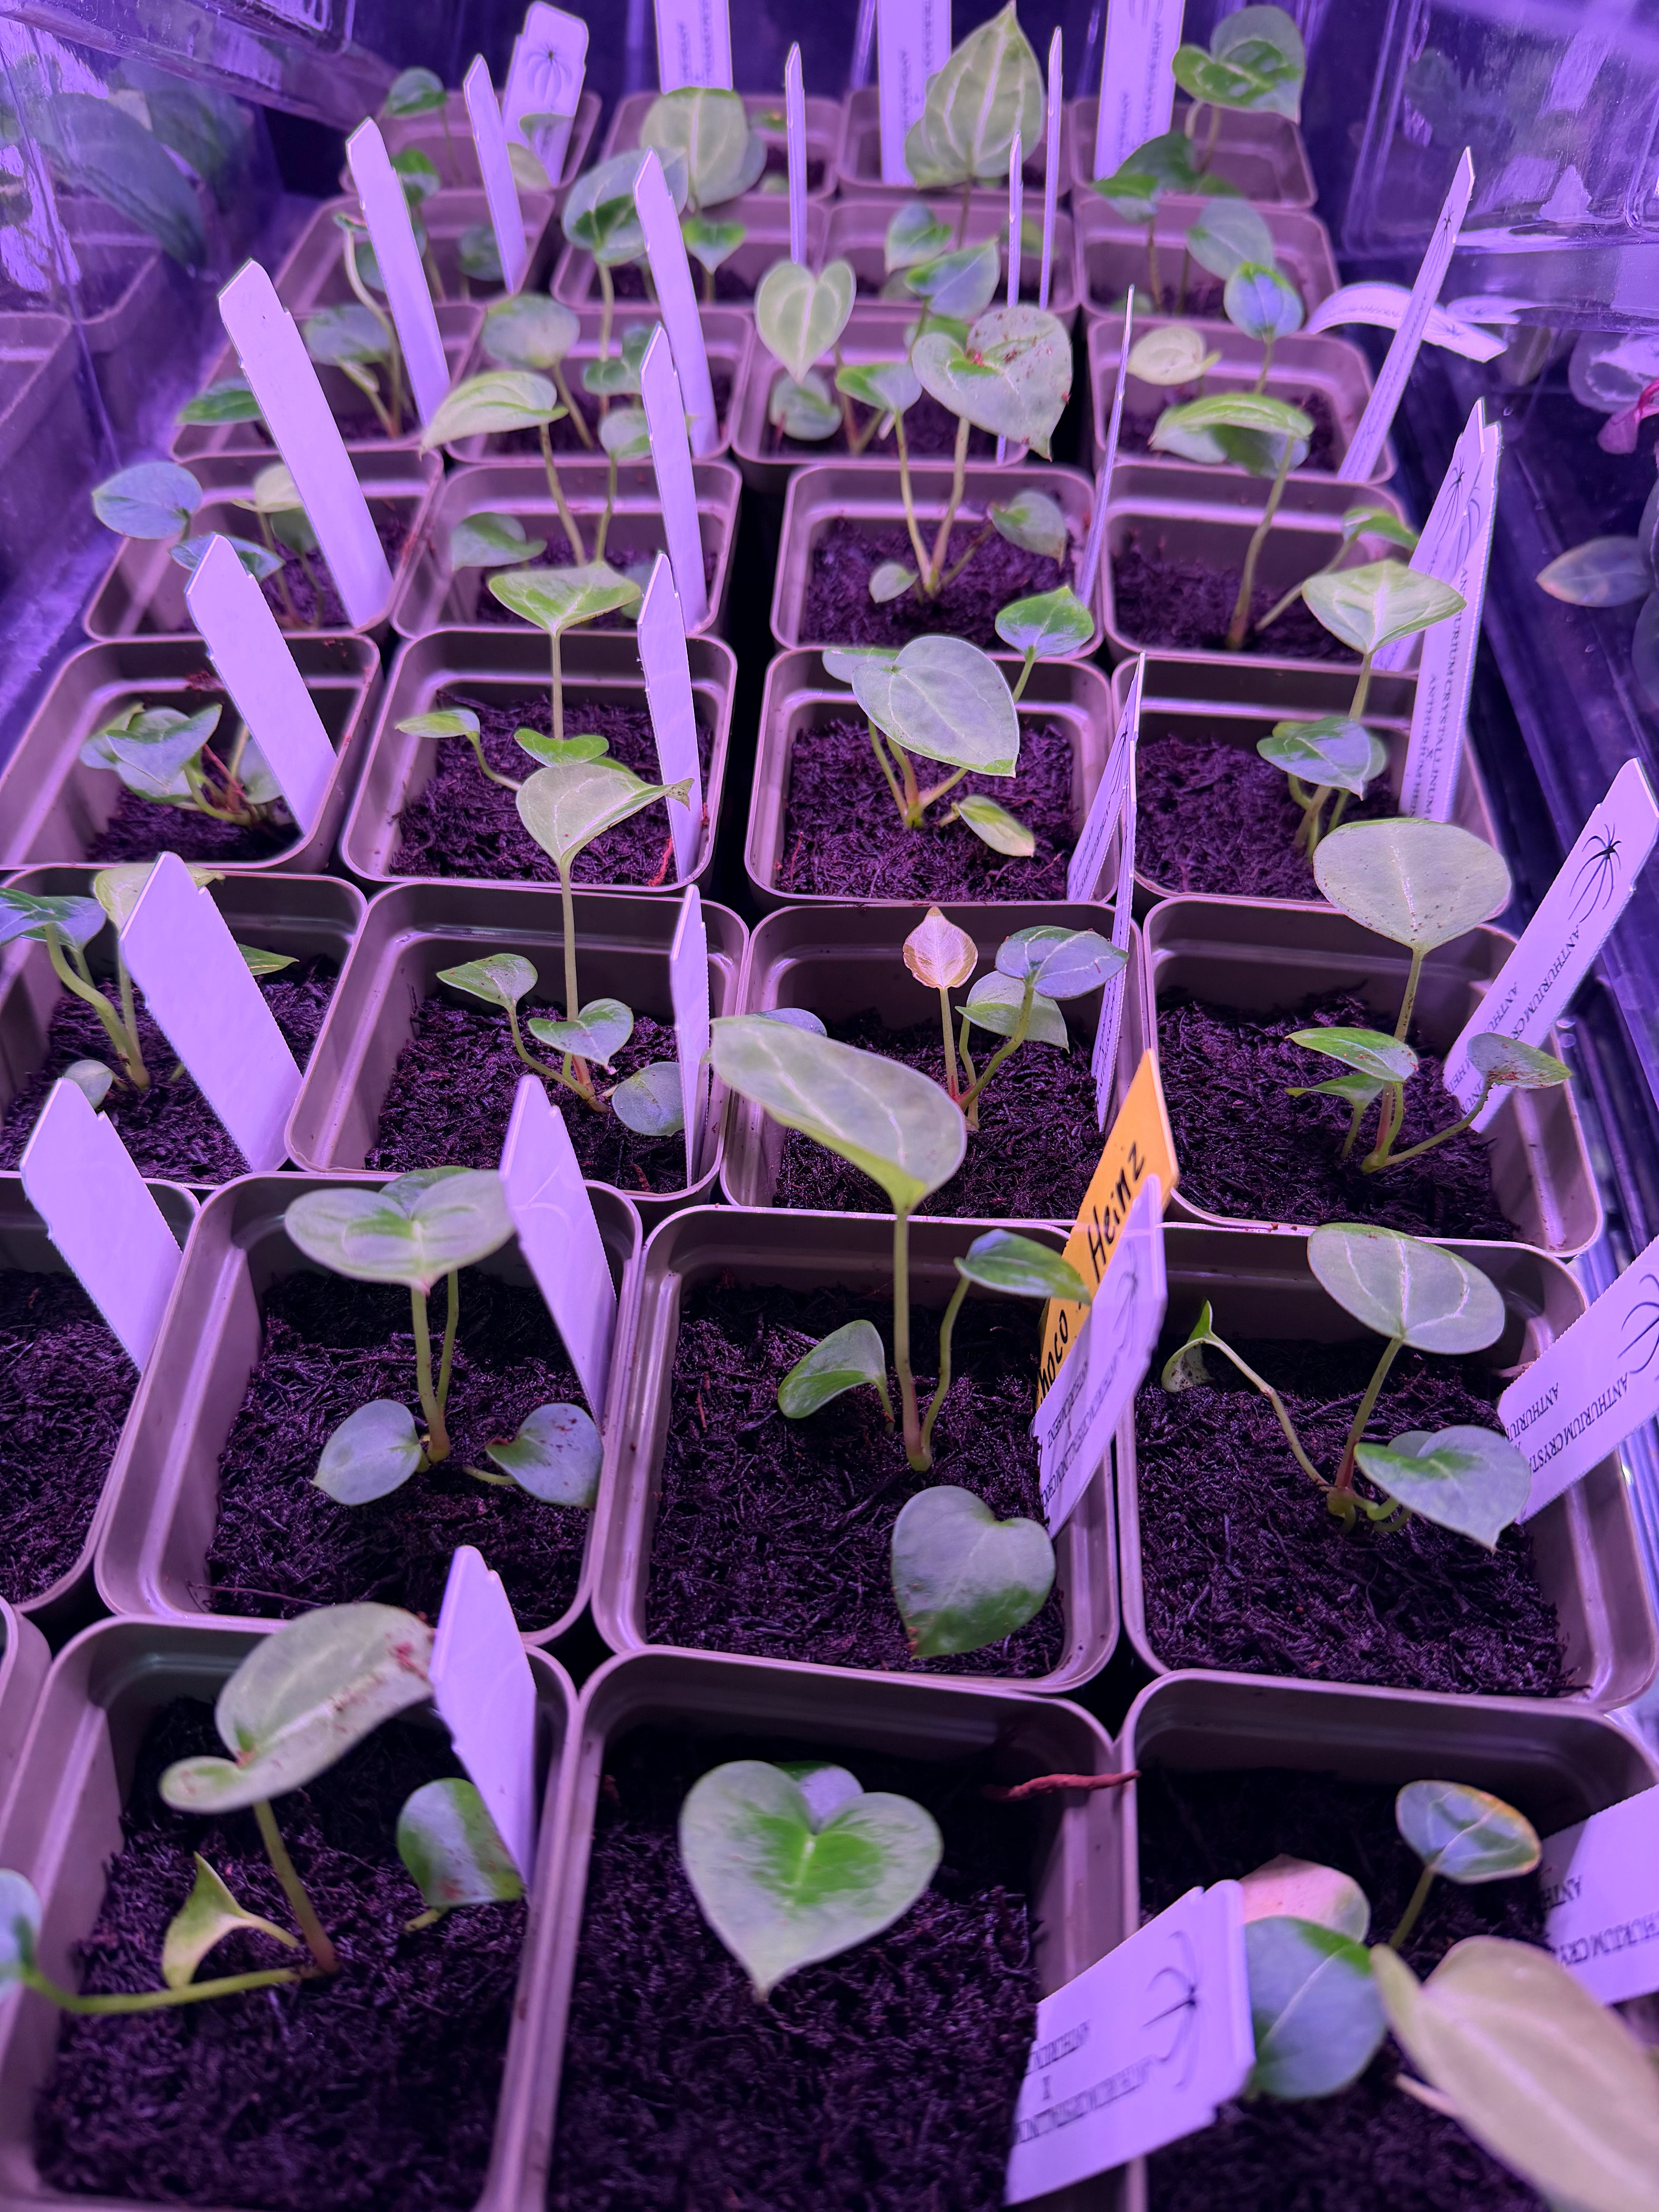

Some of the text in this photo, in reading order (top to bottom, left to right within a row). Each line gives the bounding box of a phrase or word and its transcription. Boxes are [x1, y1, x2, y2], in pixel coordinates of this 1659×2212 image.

[1523, 923, 1580, 1018] ANTHURIUM
[1094, 1141, 1147, 1283] Heinz
[1563, 1372, 1627, 1446] ANTHURIUM
